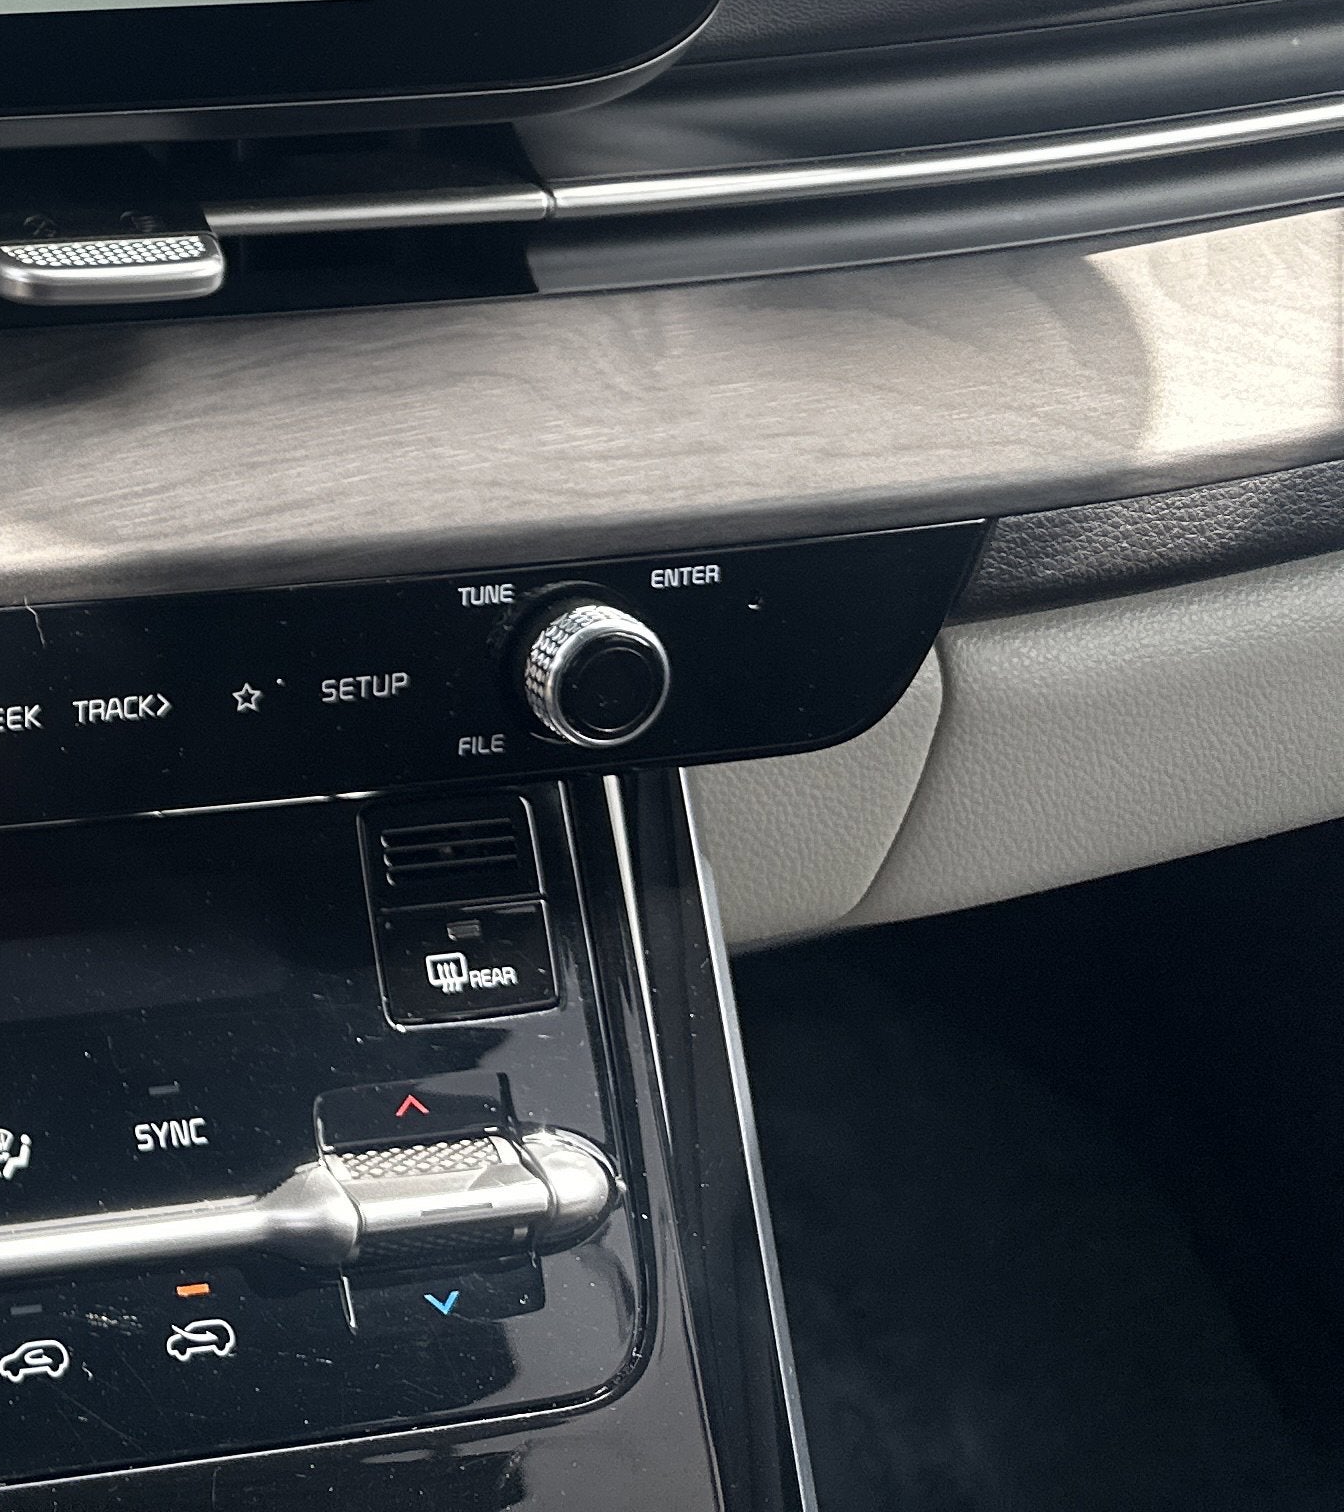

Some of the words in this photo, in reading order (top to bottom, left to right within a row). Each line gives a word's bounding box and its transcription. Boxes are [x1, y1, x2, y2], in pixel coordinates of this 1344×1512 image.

[650, 564, 720, 588] ENTER
[457, 583, 513, 606] TUNE
[321, 672, 408, 702] SETUP
[458, 733, 504, 756] FILE
[469, 965, 518, 989] REAR
[134, 1117, 208, 1151] SYNC
